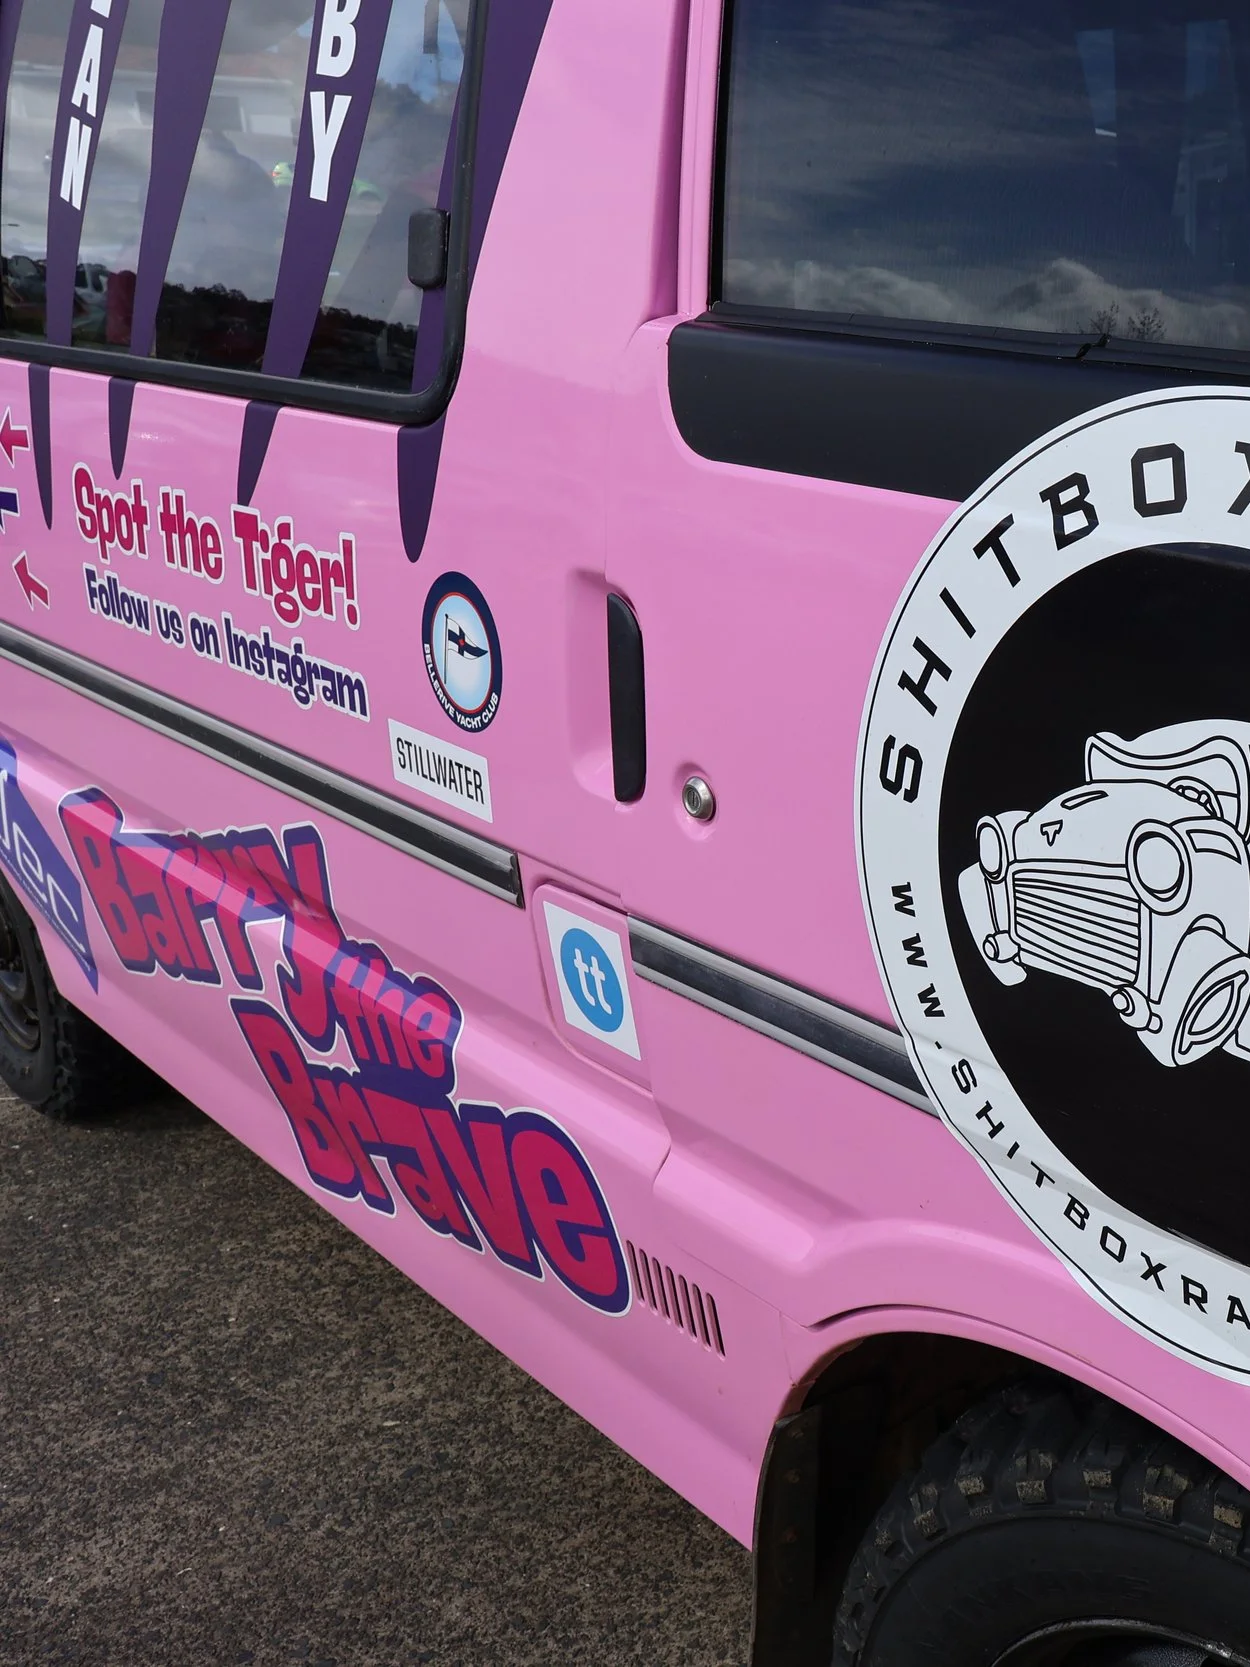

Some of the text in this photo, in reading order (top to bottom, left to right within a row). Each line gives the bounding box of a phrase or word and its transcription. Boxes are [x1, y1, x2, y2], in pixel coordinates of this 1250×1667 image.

[60, 0, 111, 211] AN
[72, 465, 359, 627] Spot the Tiger!
[83, 565, 369, 718] Follow us on Instagram
[424, 643, 499, 729] BELLERIVE YACHT CLUB
[396, 737, 485, 805] STILLWATER
[60, 790, 343, 1045] Barry
[333, 948, 455, 1082] the
[573, 948, 612, 1015] tt
[234, 1008, 621, 1302] Brave
